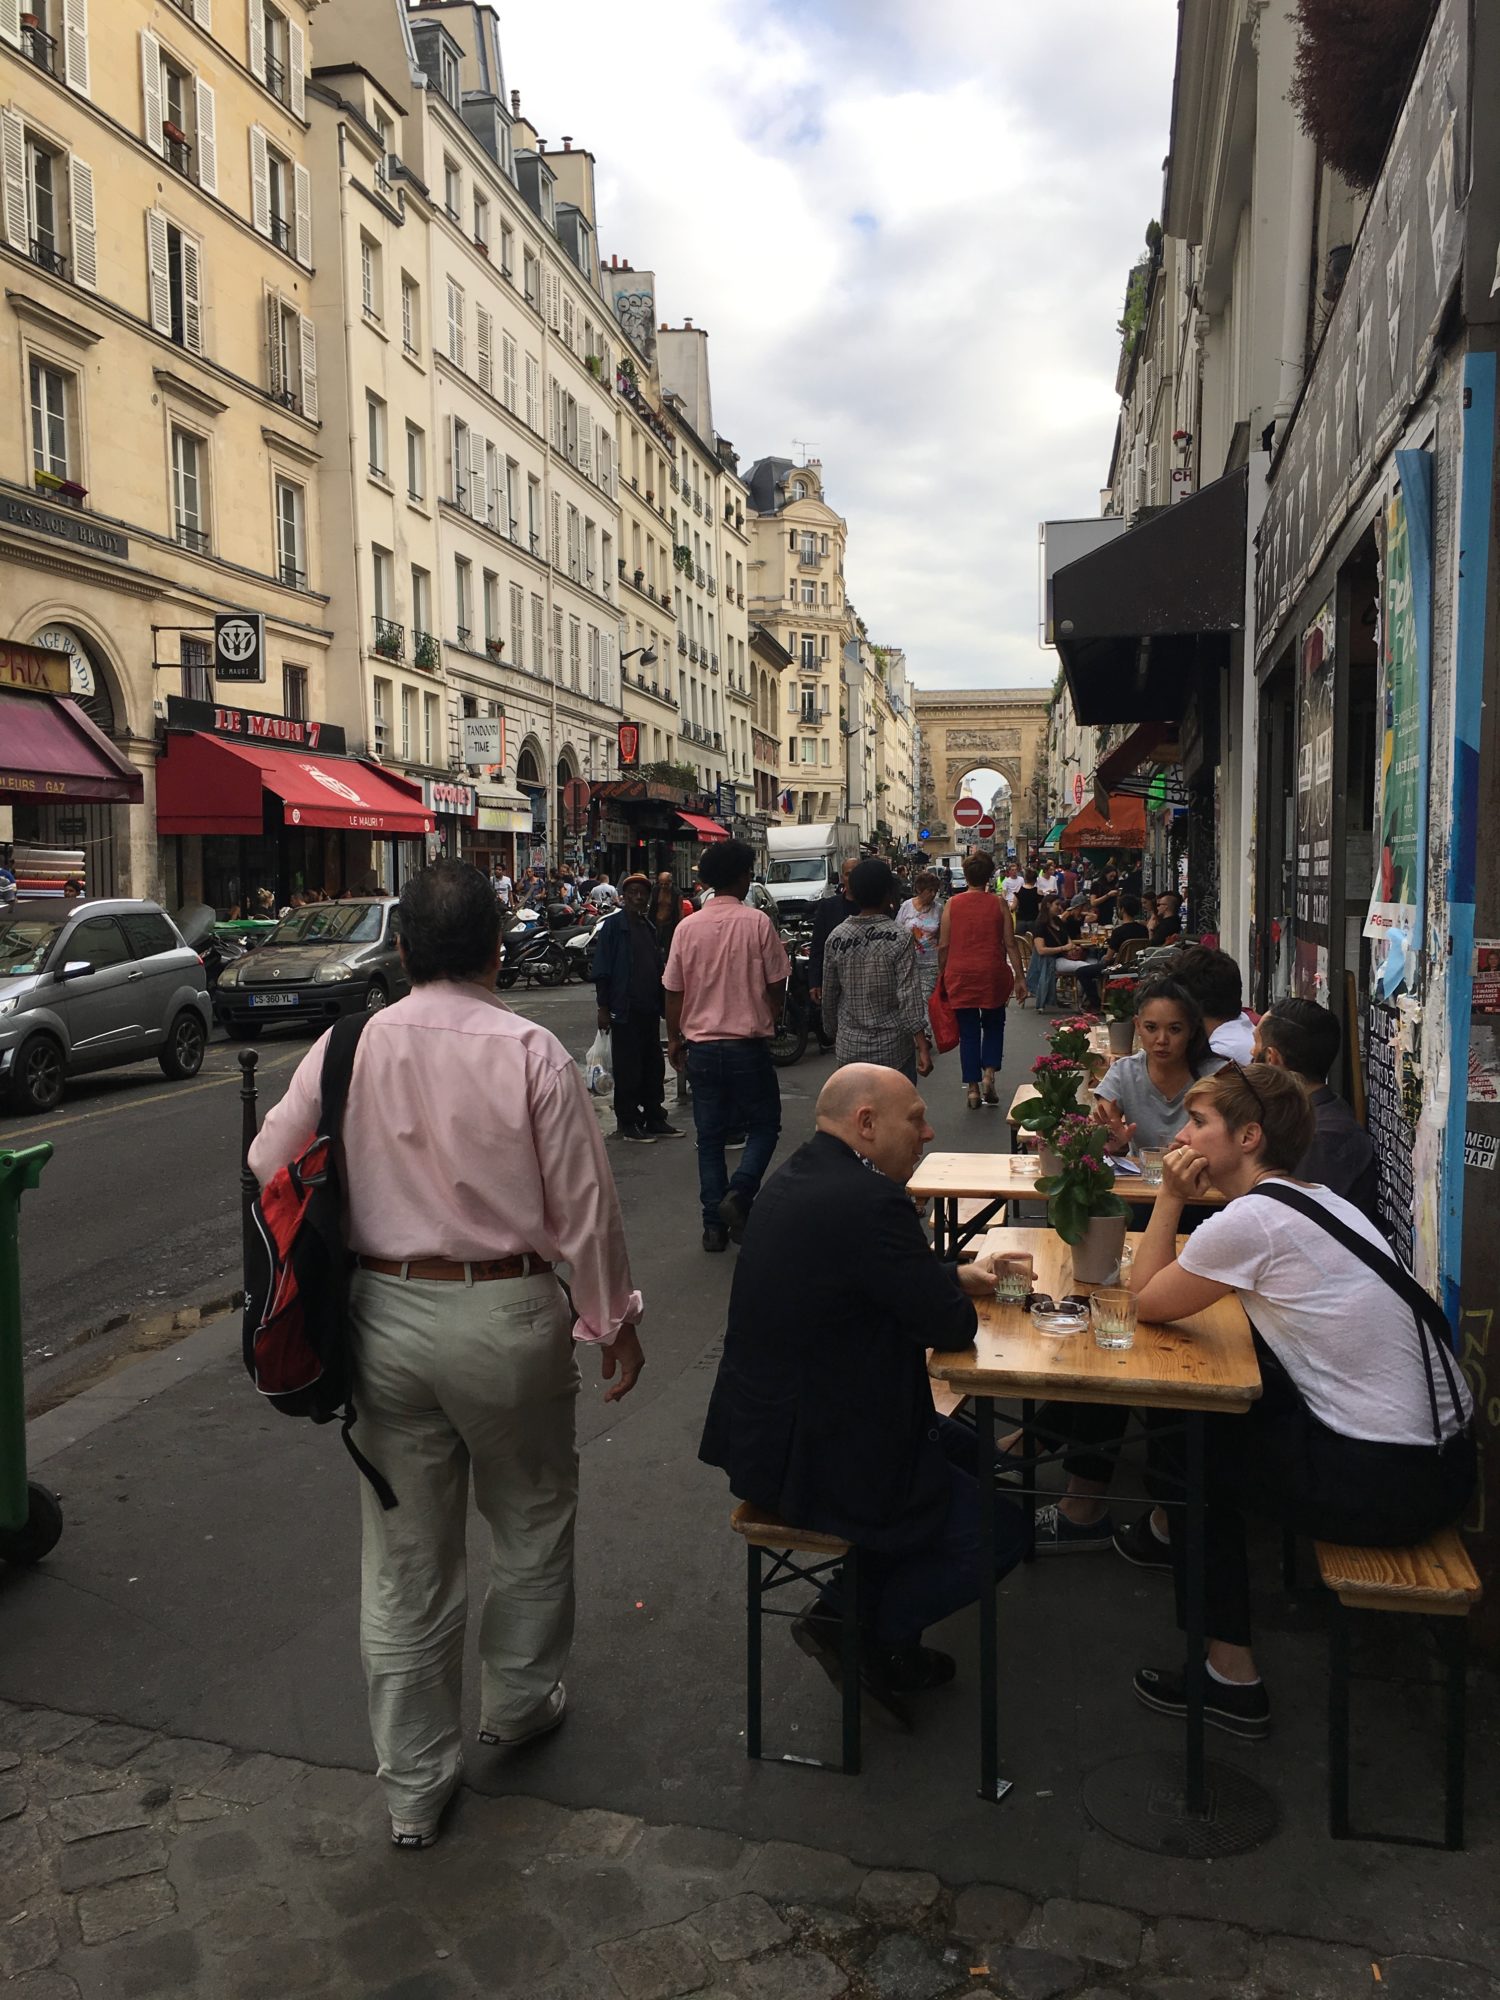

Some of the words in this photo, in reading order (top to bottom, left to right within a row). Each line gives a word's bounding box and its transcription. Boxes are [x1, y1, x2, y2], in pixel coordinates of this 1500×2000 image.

[8, 502, 66, 535] PASSAGE
[79, 526, 118, 552] BRADY
[62, 636, 90, 692] BRADY
[214, 709, 240, 732] LE
[247, 715, 304, 742] MAURI
[306, 722, 320, 748] 7
[467, 725, 498, 736] TANDOORI
[474, 741, 490, 752] TIME
[45, 781, 65, 793] GAZ
[434, 784, 471, 806] COOKIES
[349, 816, 357, 826] LE
[360, 817, 378, 826] MAURI
[379, 818, 384, 827] 7
[865, 926, 898, 946] Jeans
